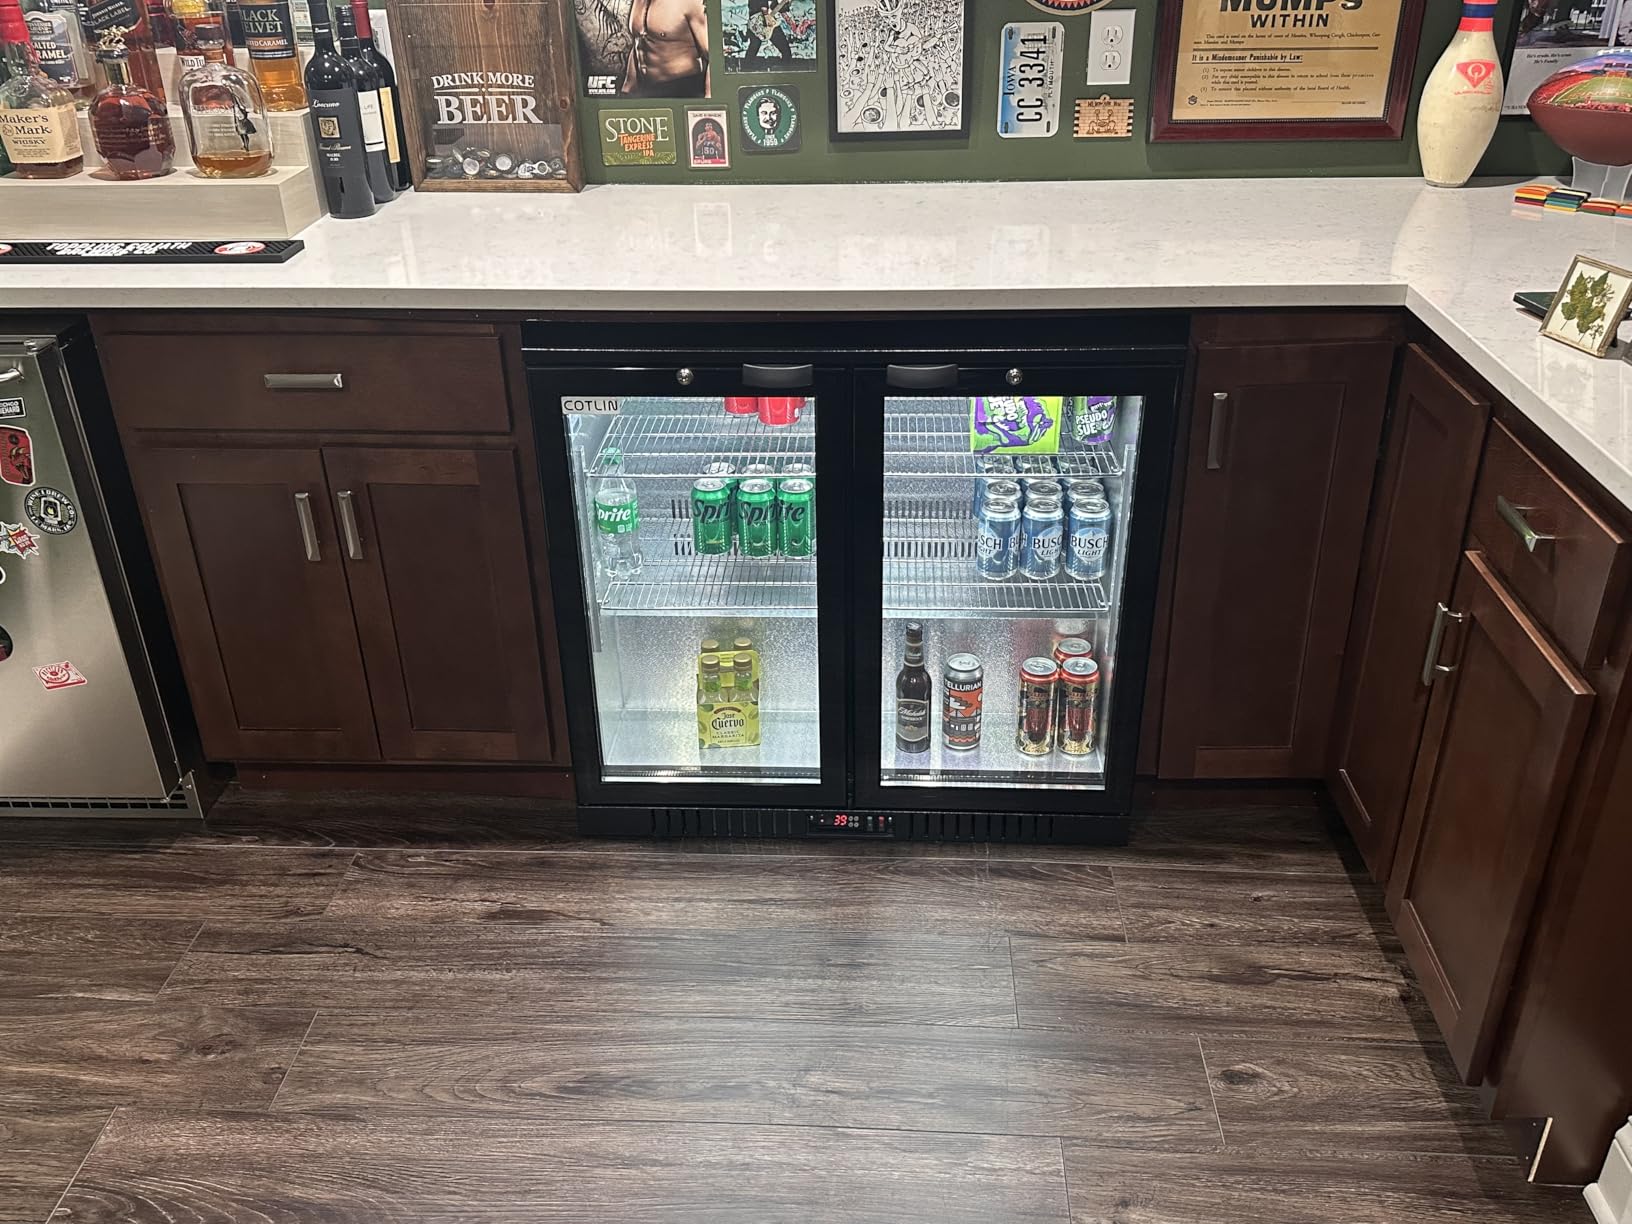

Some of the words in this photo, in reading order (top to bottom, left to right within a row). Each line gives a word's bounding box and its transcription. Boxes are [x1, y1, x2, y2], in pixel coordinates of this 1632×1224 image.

[1250, 13, 1329, 28] WITHIN
[33, 41, 56, 50] ALTED
[1018, 35, 1047, 88] 3341
[431, 72, 485, 88] DRINK
[487, 72, 535, 88] MORE
[588, 76, 617, 88] UFC
[1003, 66, 1017, 97] IOWA
[434, 95, 544, 124] BEER
[0, 114, 49, 125] Maker's
[15, 125, 53, 136] Mark
[605, 116, 670, 142] STONE
[624, 142, 654, 152] EXPRESS
[564, 400, 618, 411] COTLIN
[1076, 410, 1108, 424] PSEUDO
[1077, 422, 1098, 436] SUE
[596, 503, 632, 522] prite
[1070, 534, 1110, 550] BUSCH
[712, 717, 744, 730] Cuervo
[834, 814, 848, 826] 39
